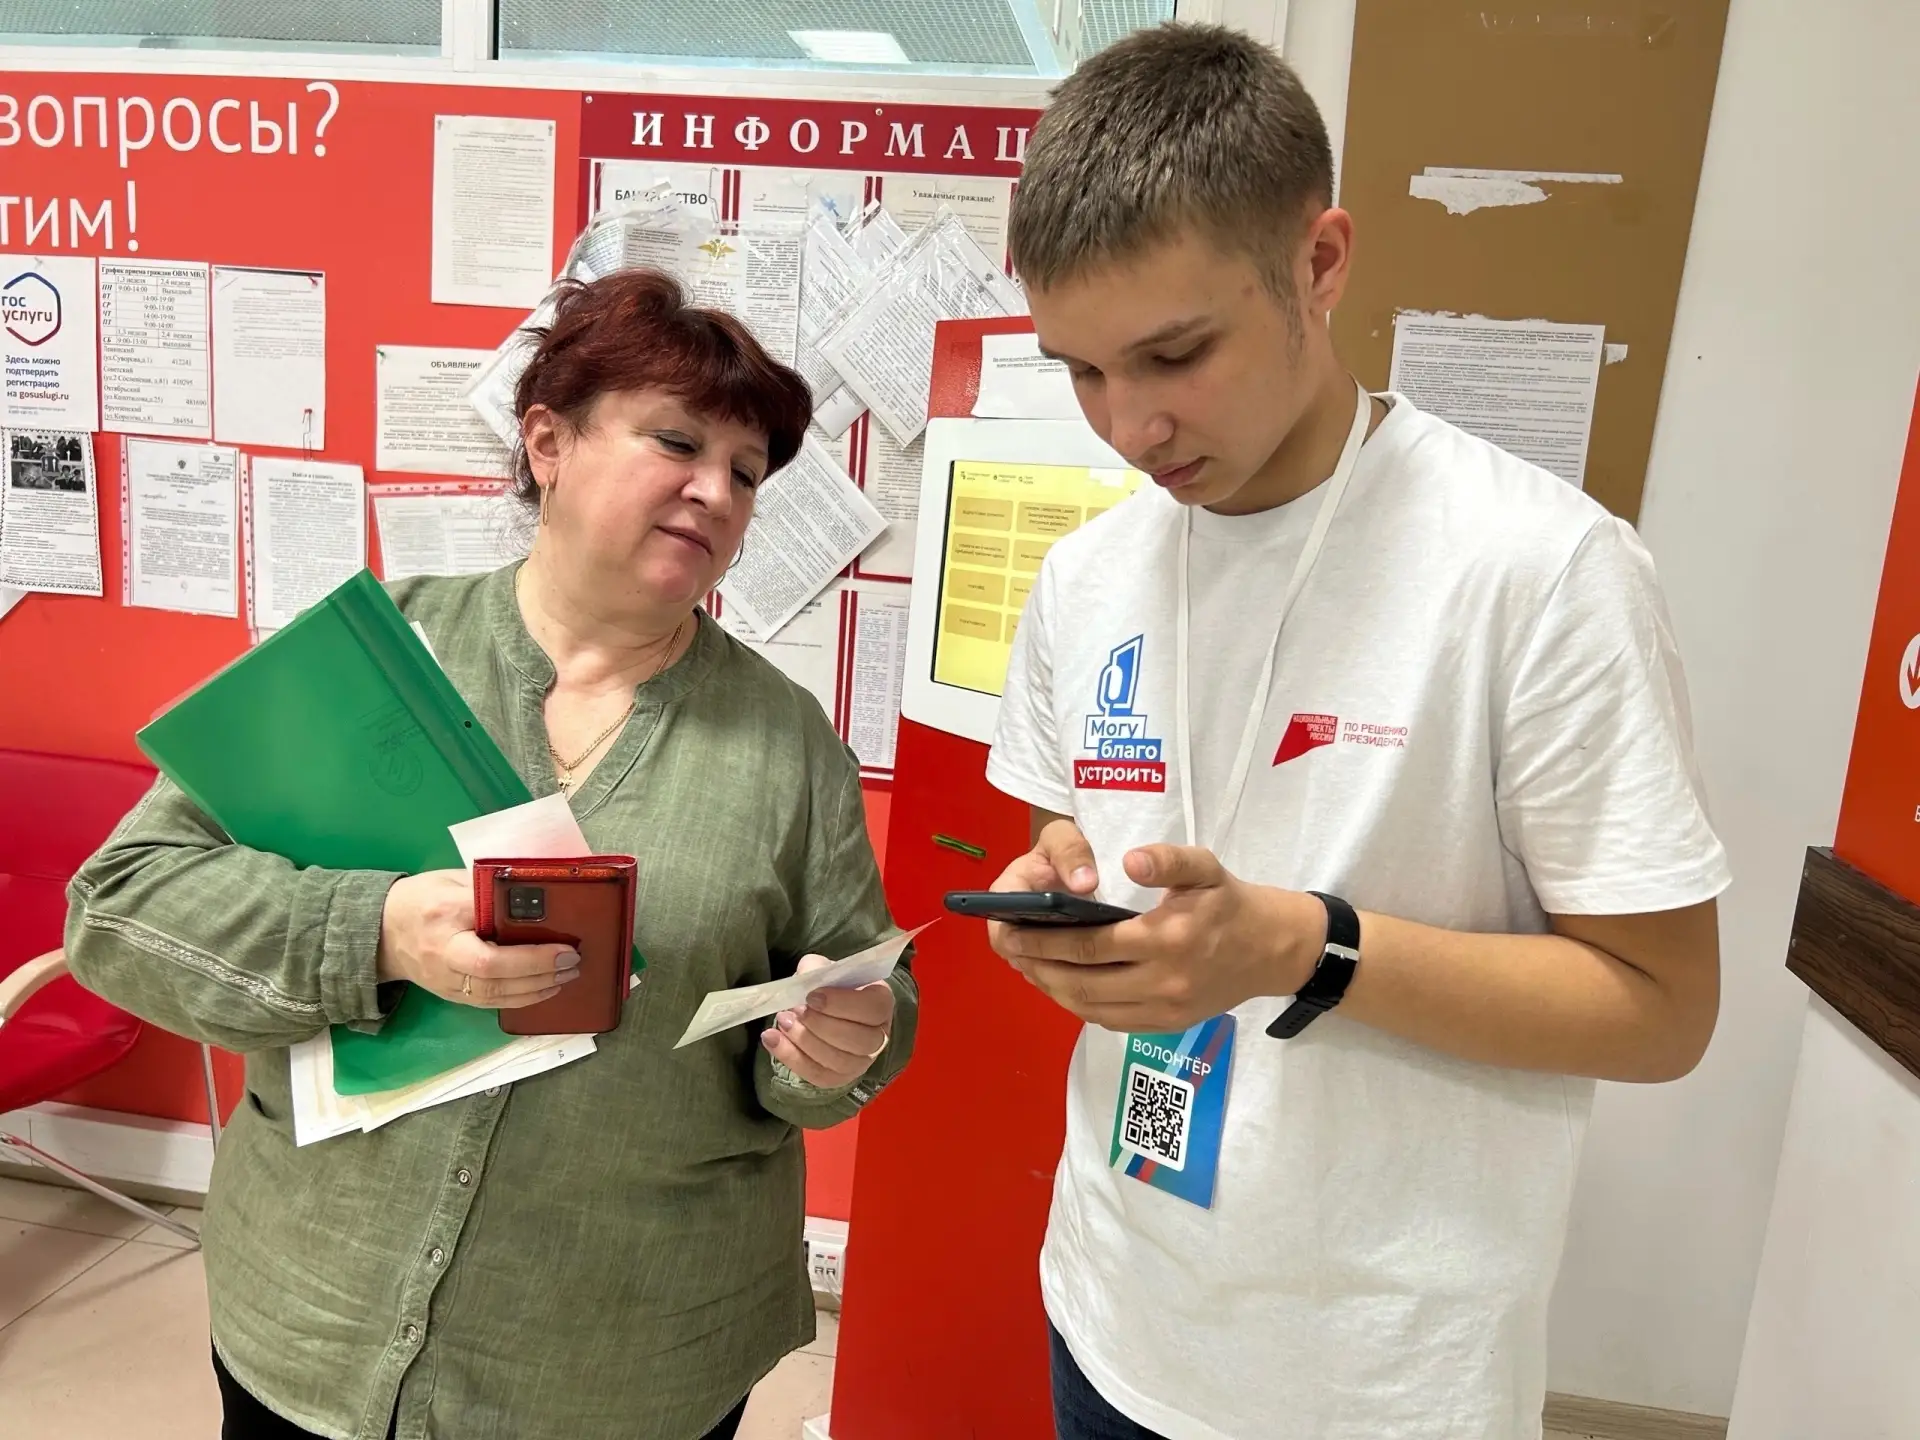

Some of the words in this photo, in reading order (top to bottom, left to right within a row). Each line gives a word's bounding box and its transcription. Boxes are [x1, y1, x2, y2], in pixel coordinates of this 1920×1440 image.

[101, 266, 125, 275] График
[5, 355, 30, 365] Здесь
[32, 357, 61, 366] можно
[5, 368, 59, 379] подтвердить
[6, 379, 60, 390] регистрацию
[7, 391, 18, 399] на
[19, 391, 70, 401] gosuslugi.ru
[1091, 719, 1139, 739] Могу
[1344, 722, 1359, 732] ПО
[1361, 723, 1408, 736] РЕШЕНИЮ
[1342, 733, 1405, 748] ПРЕЗИДЕНТА
[1101, 739, 1158, 760] благо
[1078, 766, 1163, 785] устроить
[1131, 1037, 1212, 1077] ВОЛОНТЁР
